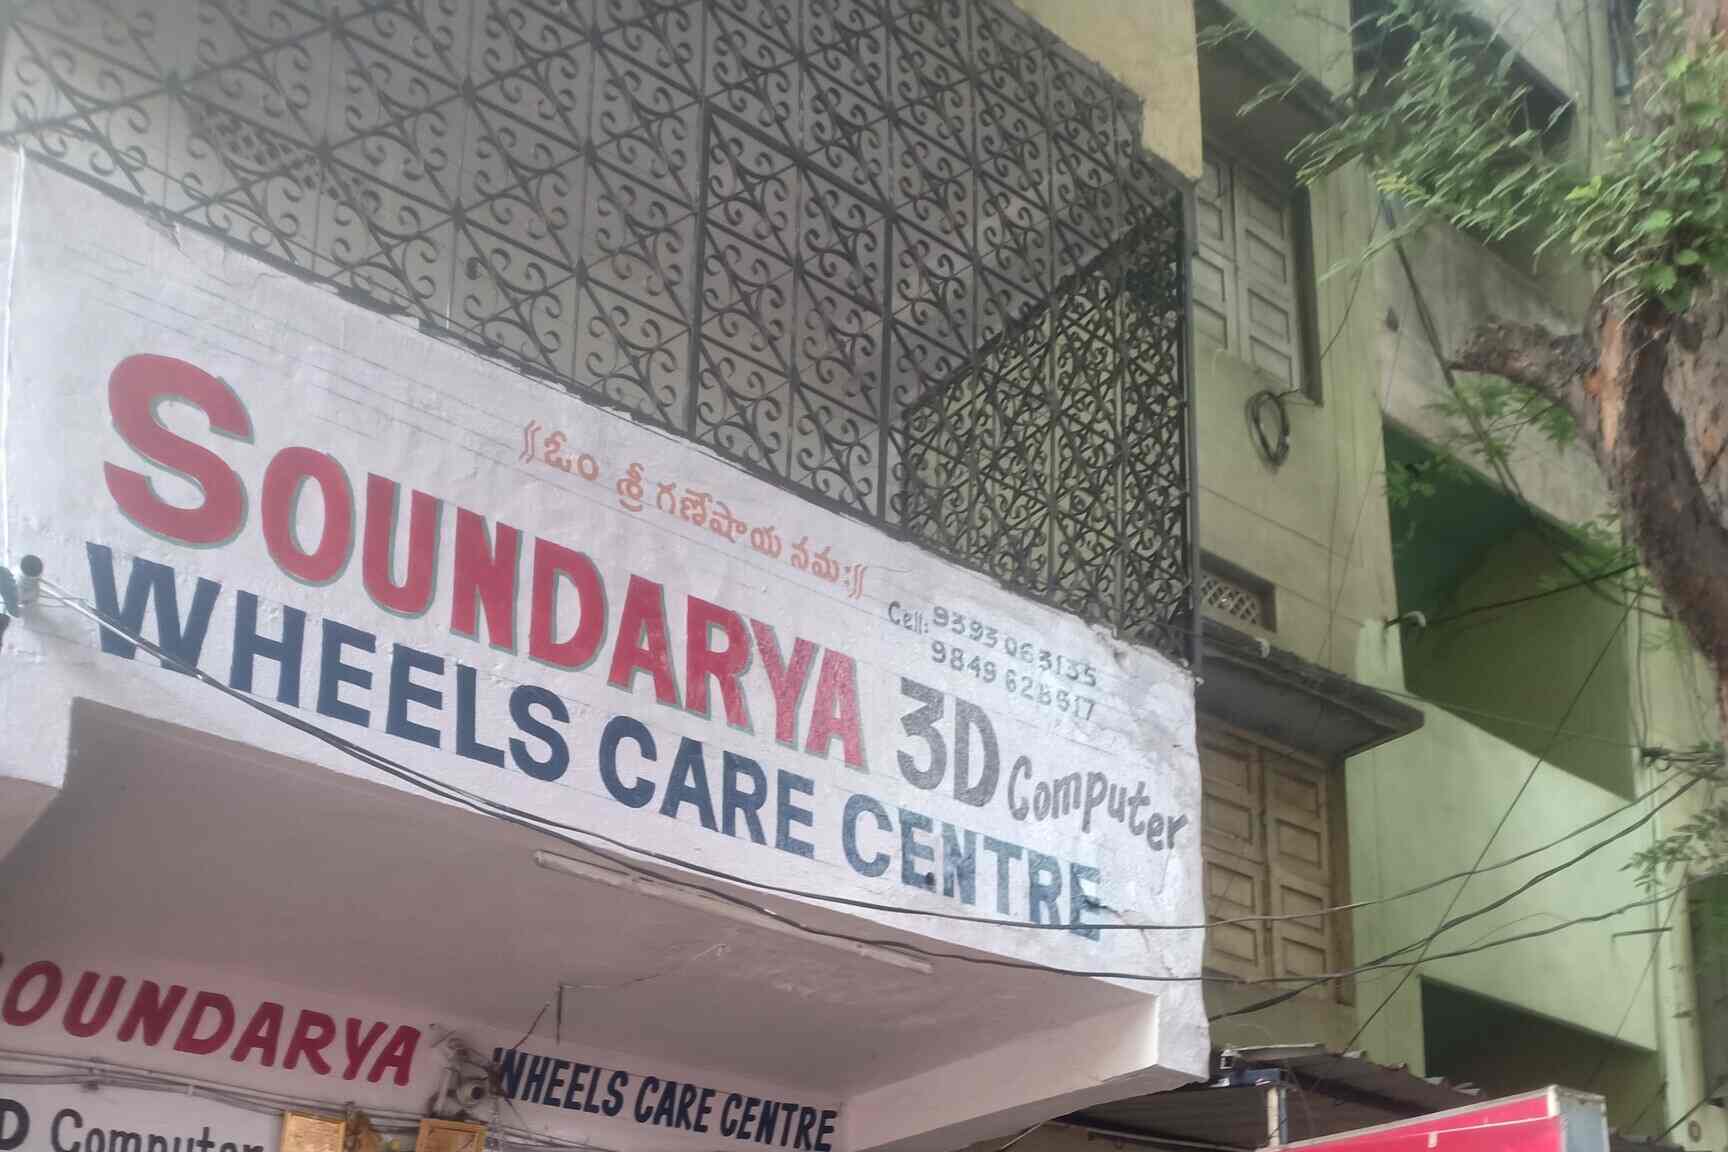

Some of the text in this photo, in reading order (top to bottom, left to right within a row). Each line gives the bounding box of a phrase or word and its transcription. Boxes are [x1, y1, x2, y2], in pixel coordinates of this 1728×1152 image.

[104, 353, 869, 774] SOUNDARYA
[888, 601, 929, 634] Cell:
[86, 540, 1104, 942] WHEELS CARE CENTRE
[896, 676, 1189, 852] 3D Computer
[0, 953, 422, 1087] OUNDARYA
[493, 1047, 838, 1152] WHEELS CARE CENTRE
